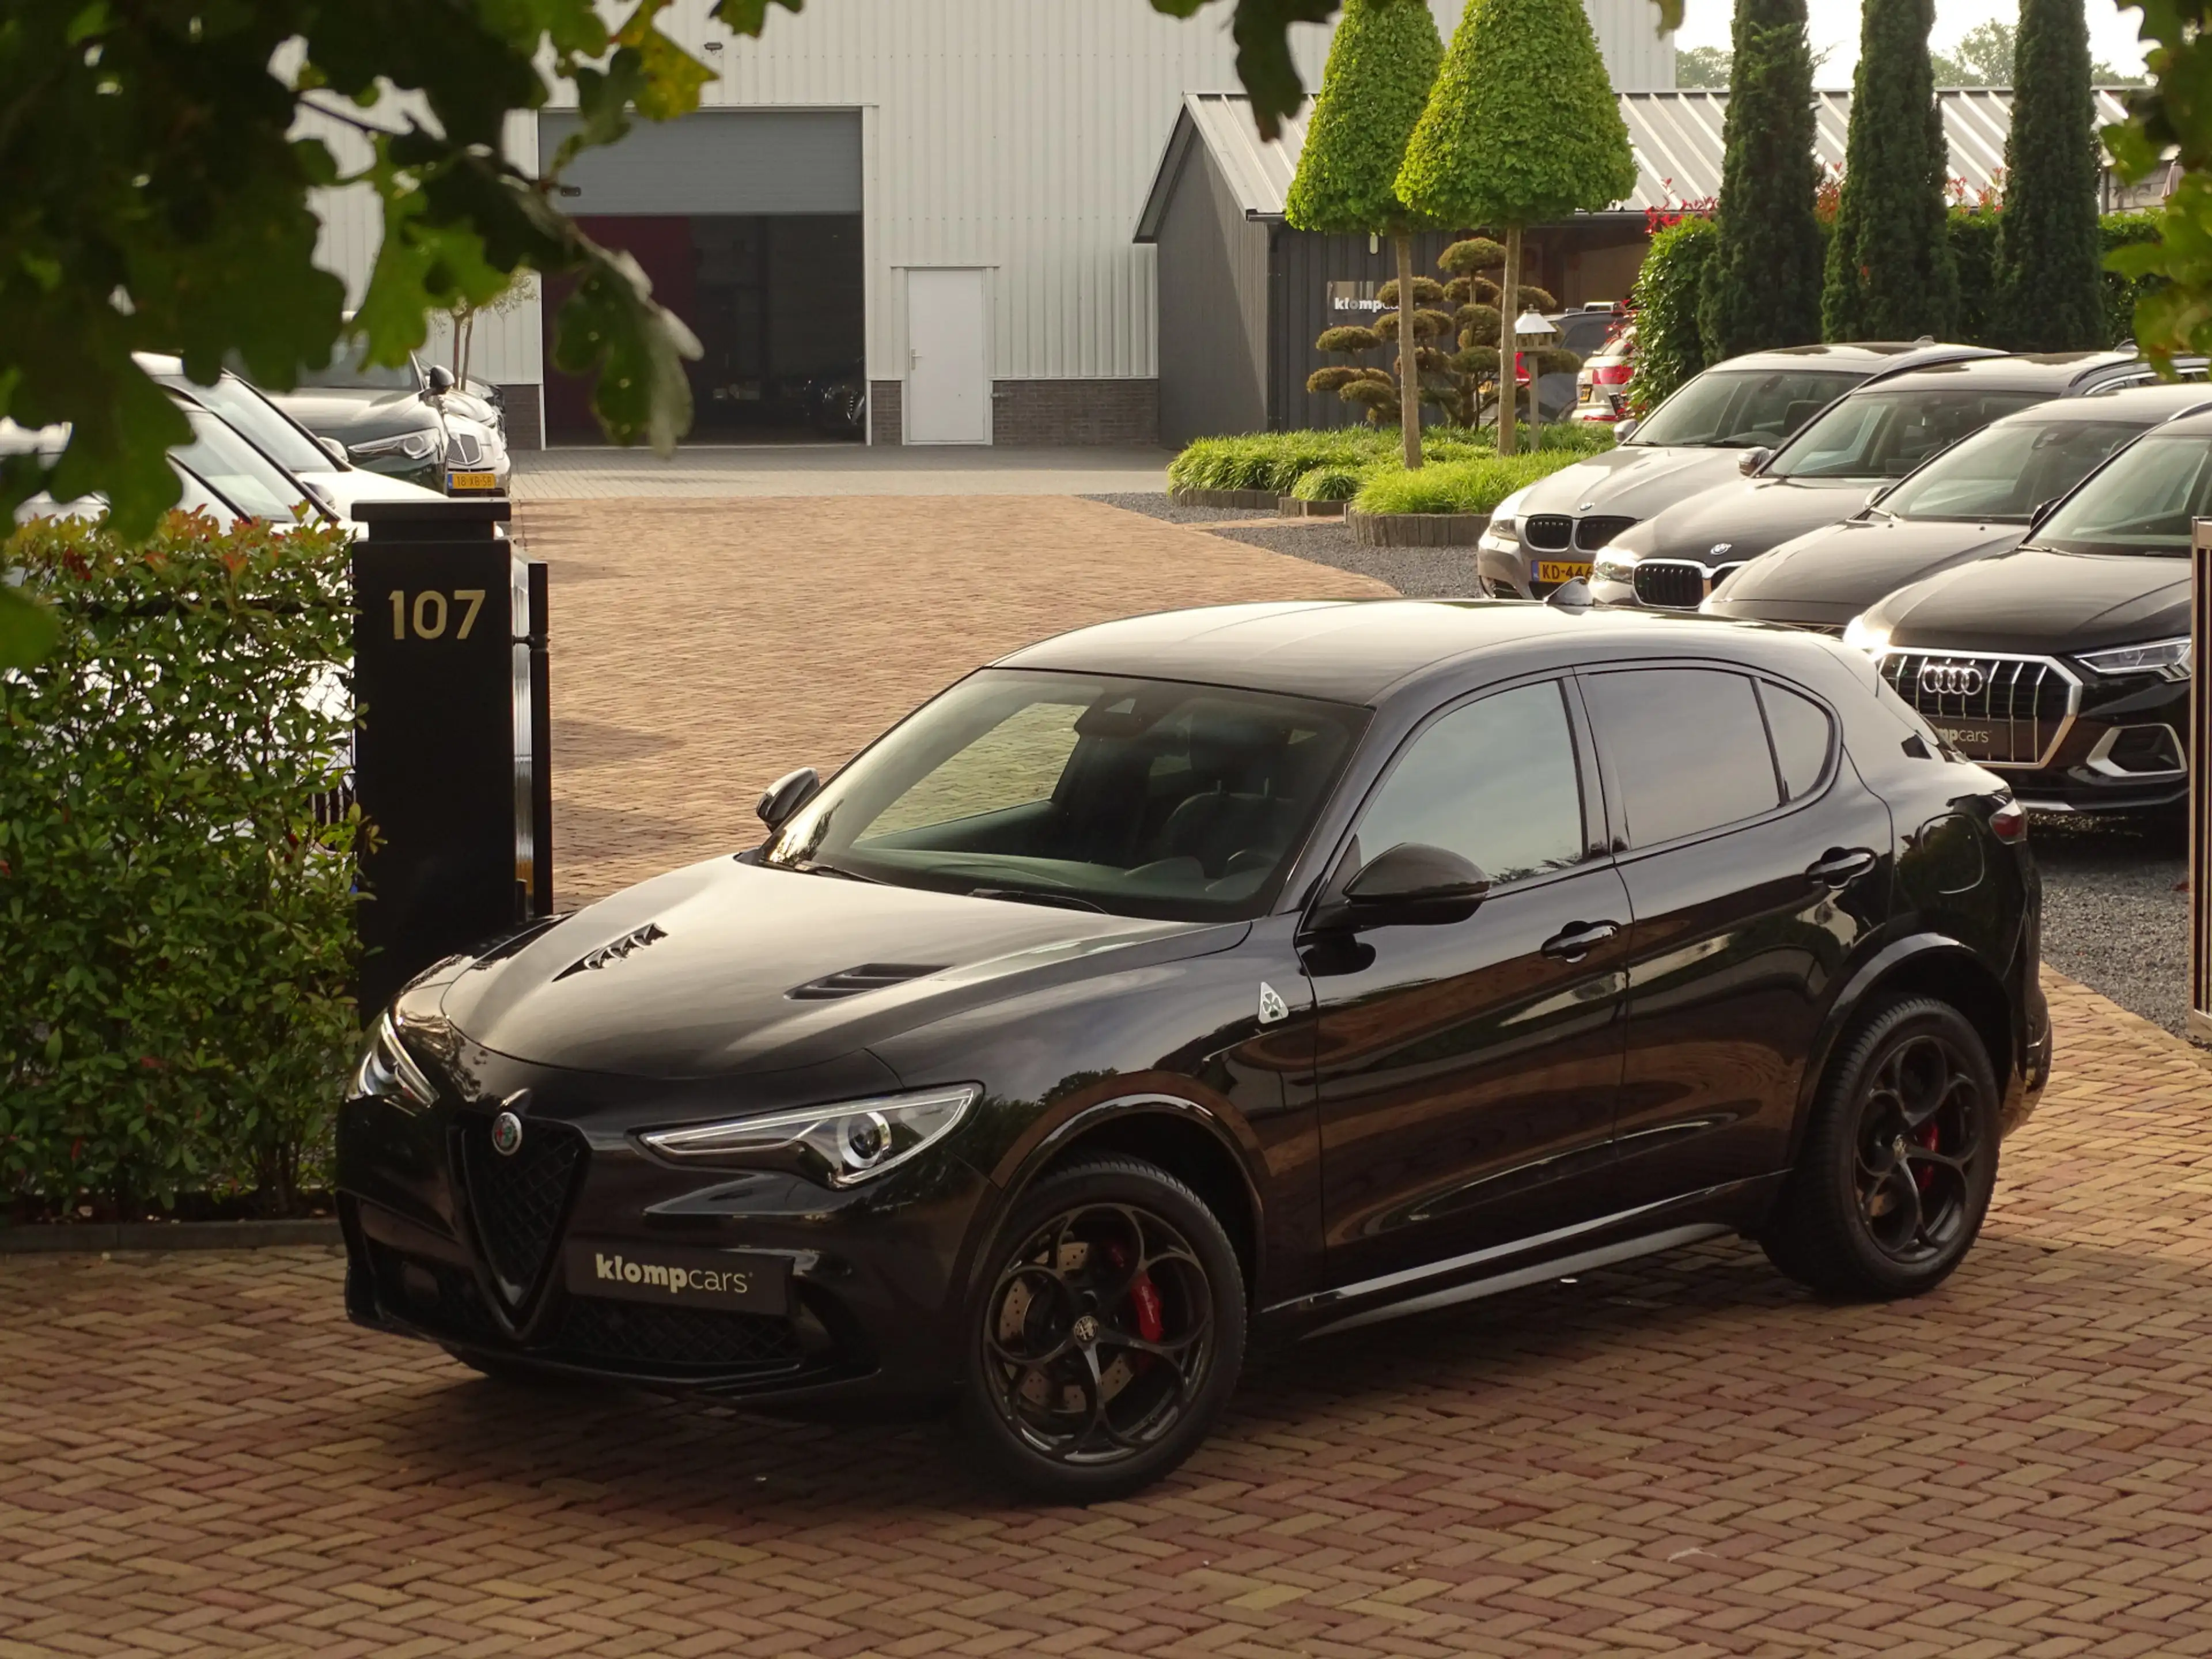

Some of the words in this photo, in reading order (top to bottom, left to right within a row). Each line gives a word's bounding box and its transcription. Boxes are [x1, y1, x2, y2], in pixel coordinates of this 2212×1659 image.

[1334, 297, 1399, 313] klomp
[388, 590, 486, 639] 107
[1937, 728, 1989, 743] mpcars
[596, 1253, 748, 1293] klompcars
